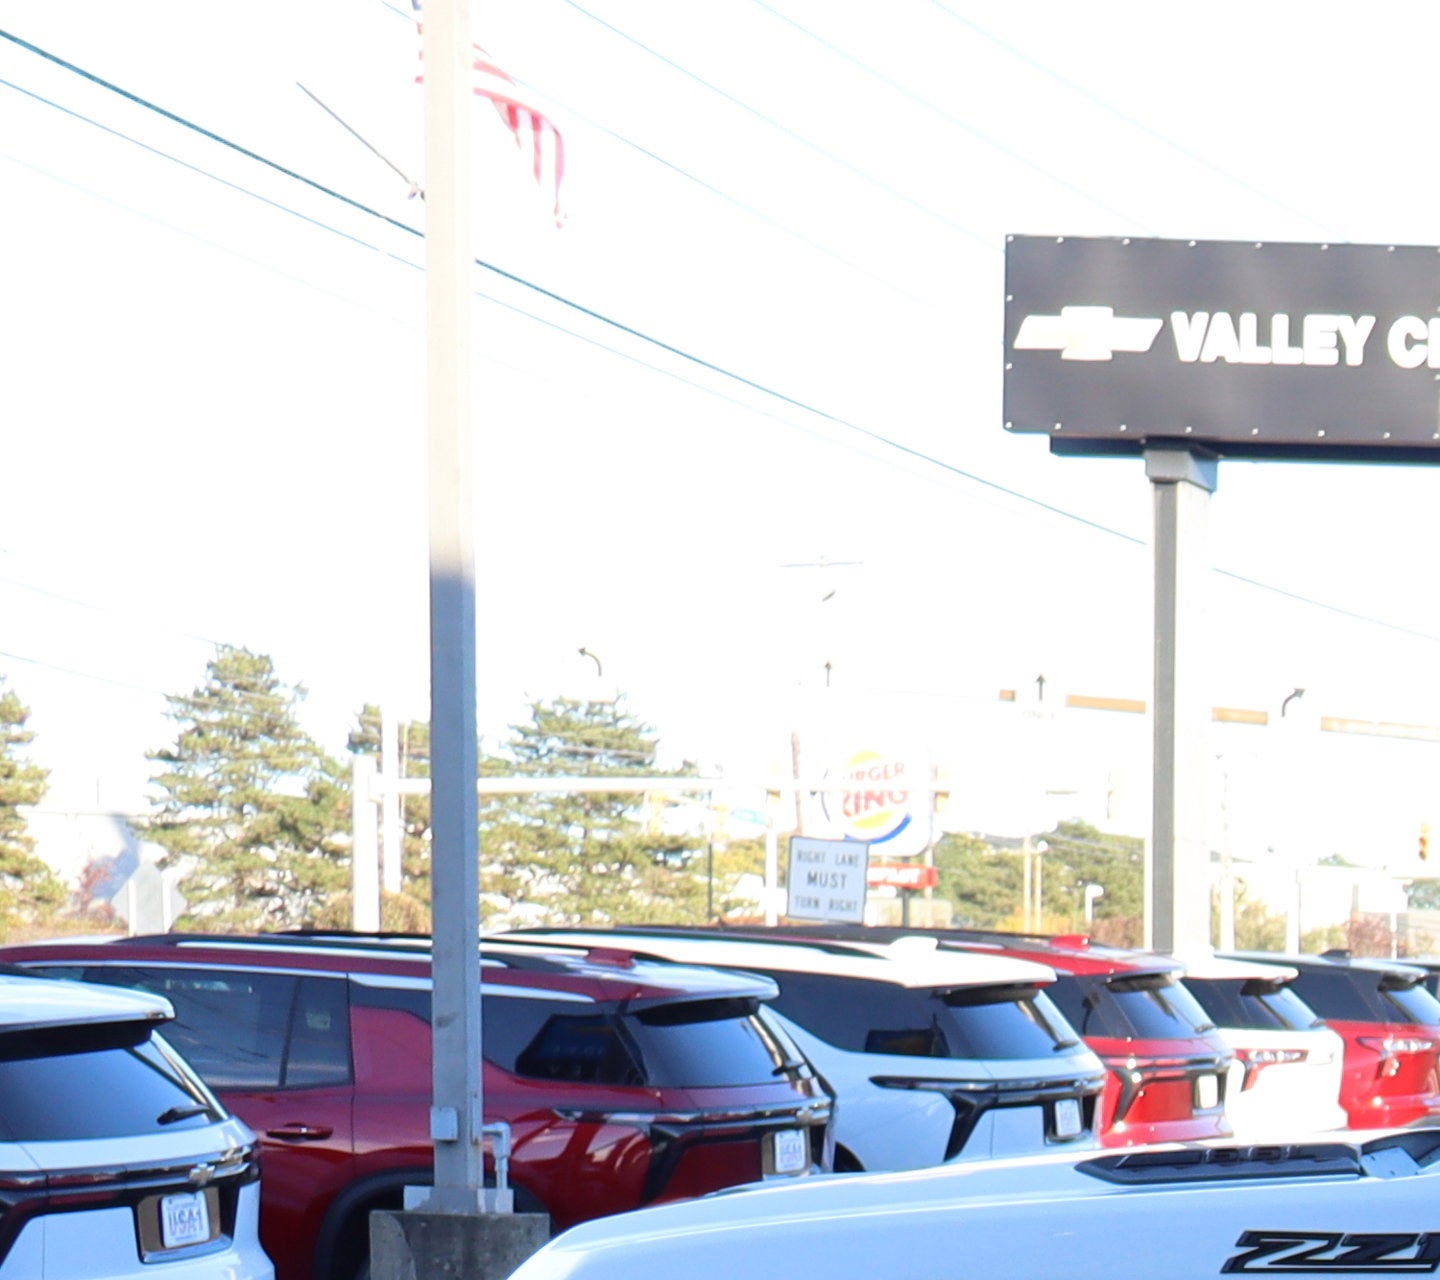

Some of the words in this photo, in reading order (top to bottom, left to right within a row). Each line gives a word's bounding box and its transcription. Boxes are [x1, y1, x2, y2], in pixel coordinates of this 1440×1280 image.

[1171, 311, 1376, 366] VALLEY
[797, 849, 827, 864] RIGHT
[835, 853, 860, 868] LANE
[806, 870, 847, 889] MUST
